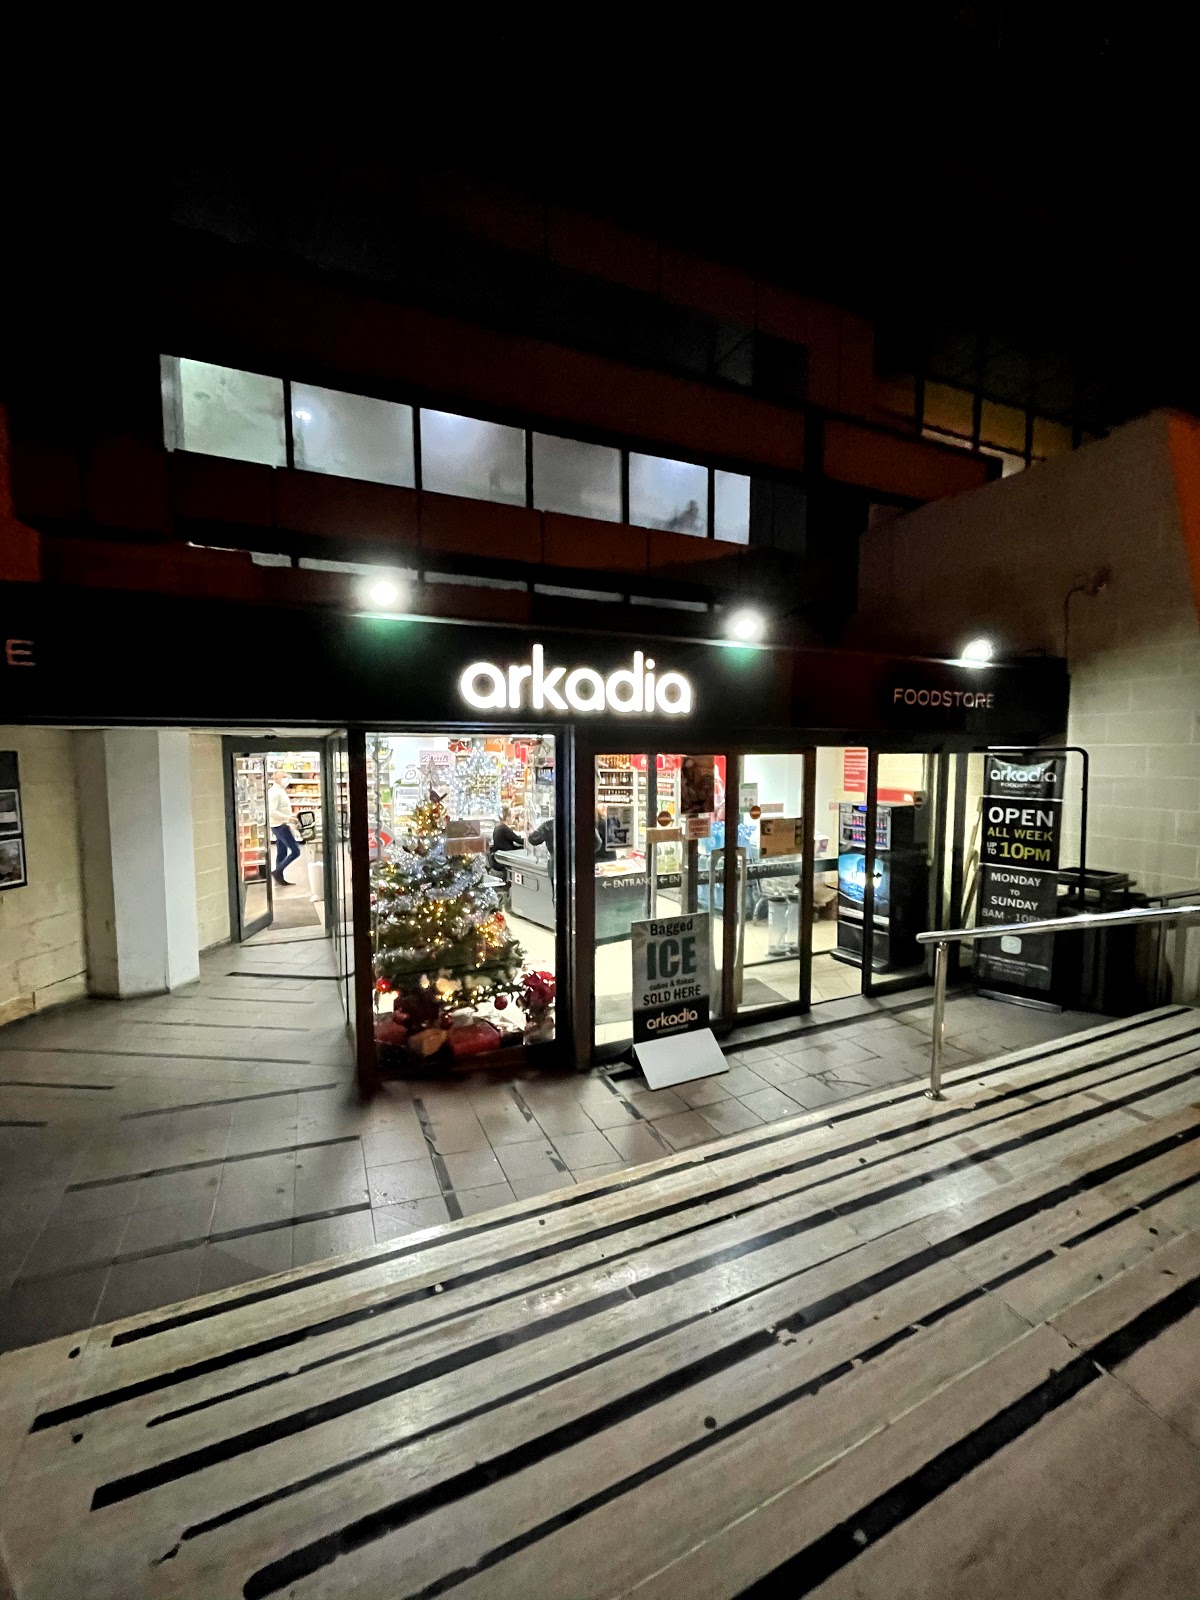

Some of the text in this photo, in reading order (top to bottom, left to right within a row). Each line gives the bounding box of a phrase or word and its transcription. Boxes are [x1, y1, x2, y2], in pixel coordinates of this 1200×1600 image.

[5, 639, 36, 666] E
[460, 643, 692, 714] arkadia
[893, 688, 995, 708] FOODSTORE
[990, 765, 1057, 782] arkadia
[988, 806, 1054, 827] OPEN
[987, 827, 1053, 842] ALL WEEK
[987, 847, 997, 855] TO
[999, 842, 1051, 862] 10PM
[612, 876, 652, 889] ENTRANC
[990, 872, 1042, 887] MONDAY
[1009, 888, 1020, 896] TO
[990, 895, 1039, 911] SUNDAY
[981, 908, 1005, 920] 8AM
[649, 919, 693, 937] Bagged
[646, 936, 697, 981] ICE
[643, 985, 701, 1006] SOLD HERE
[646, 1007, 698, 1030] arkadia
